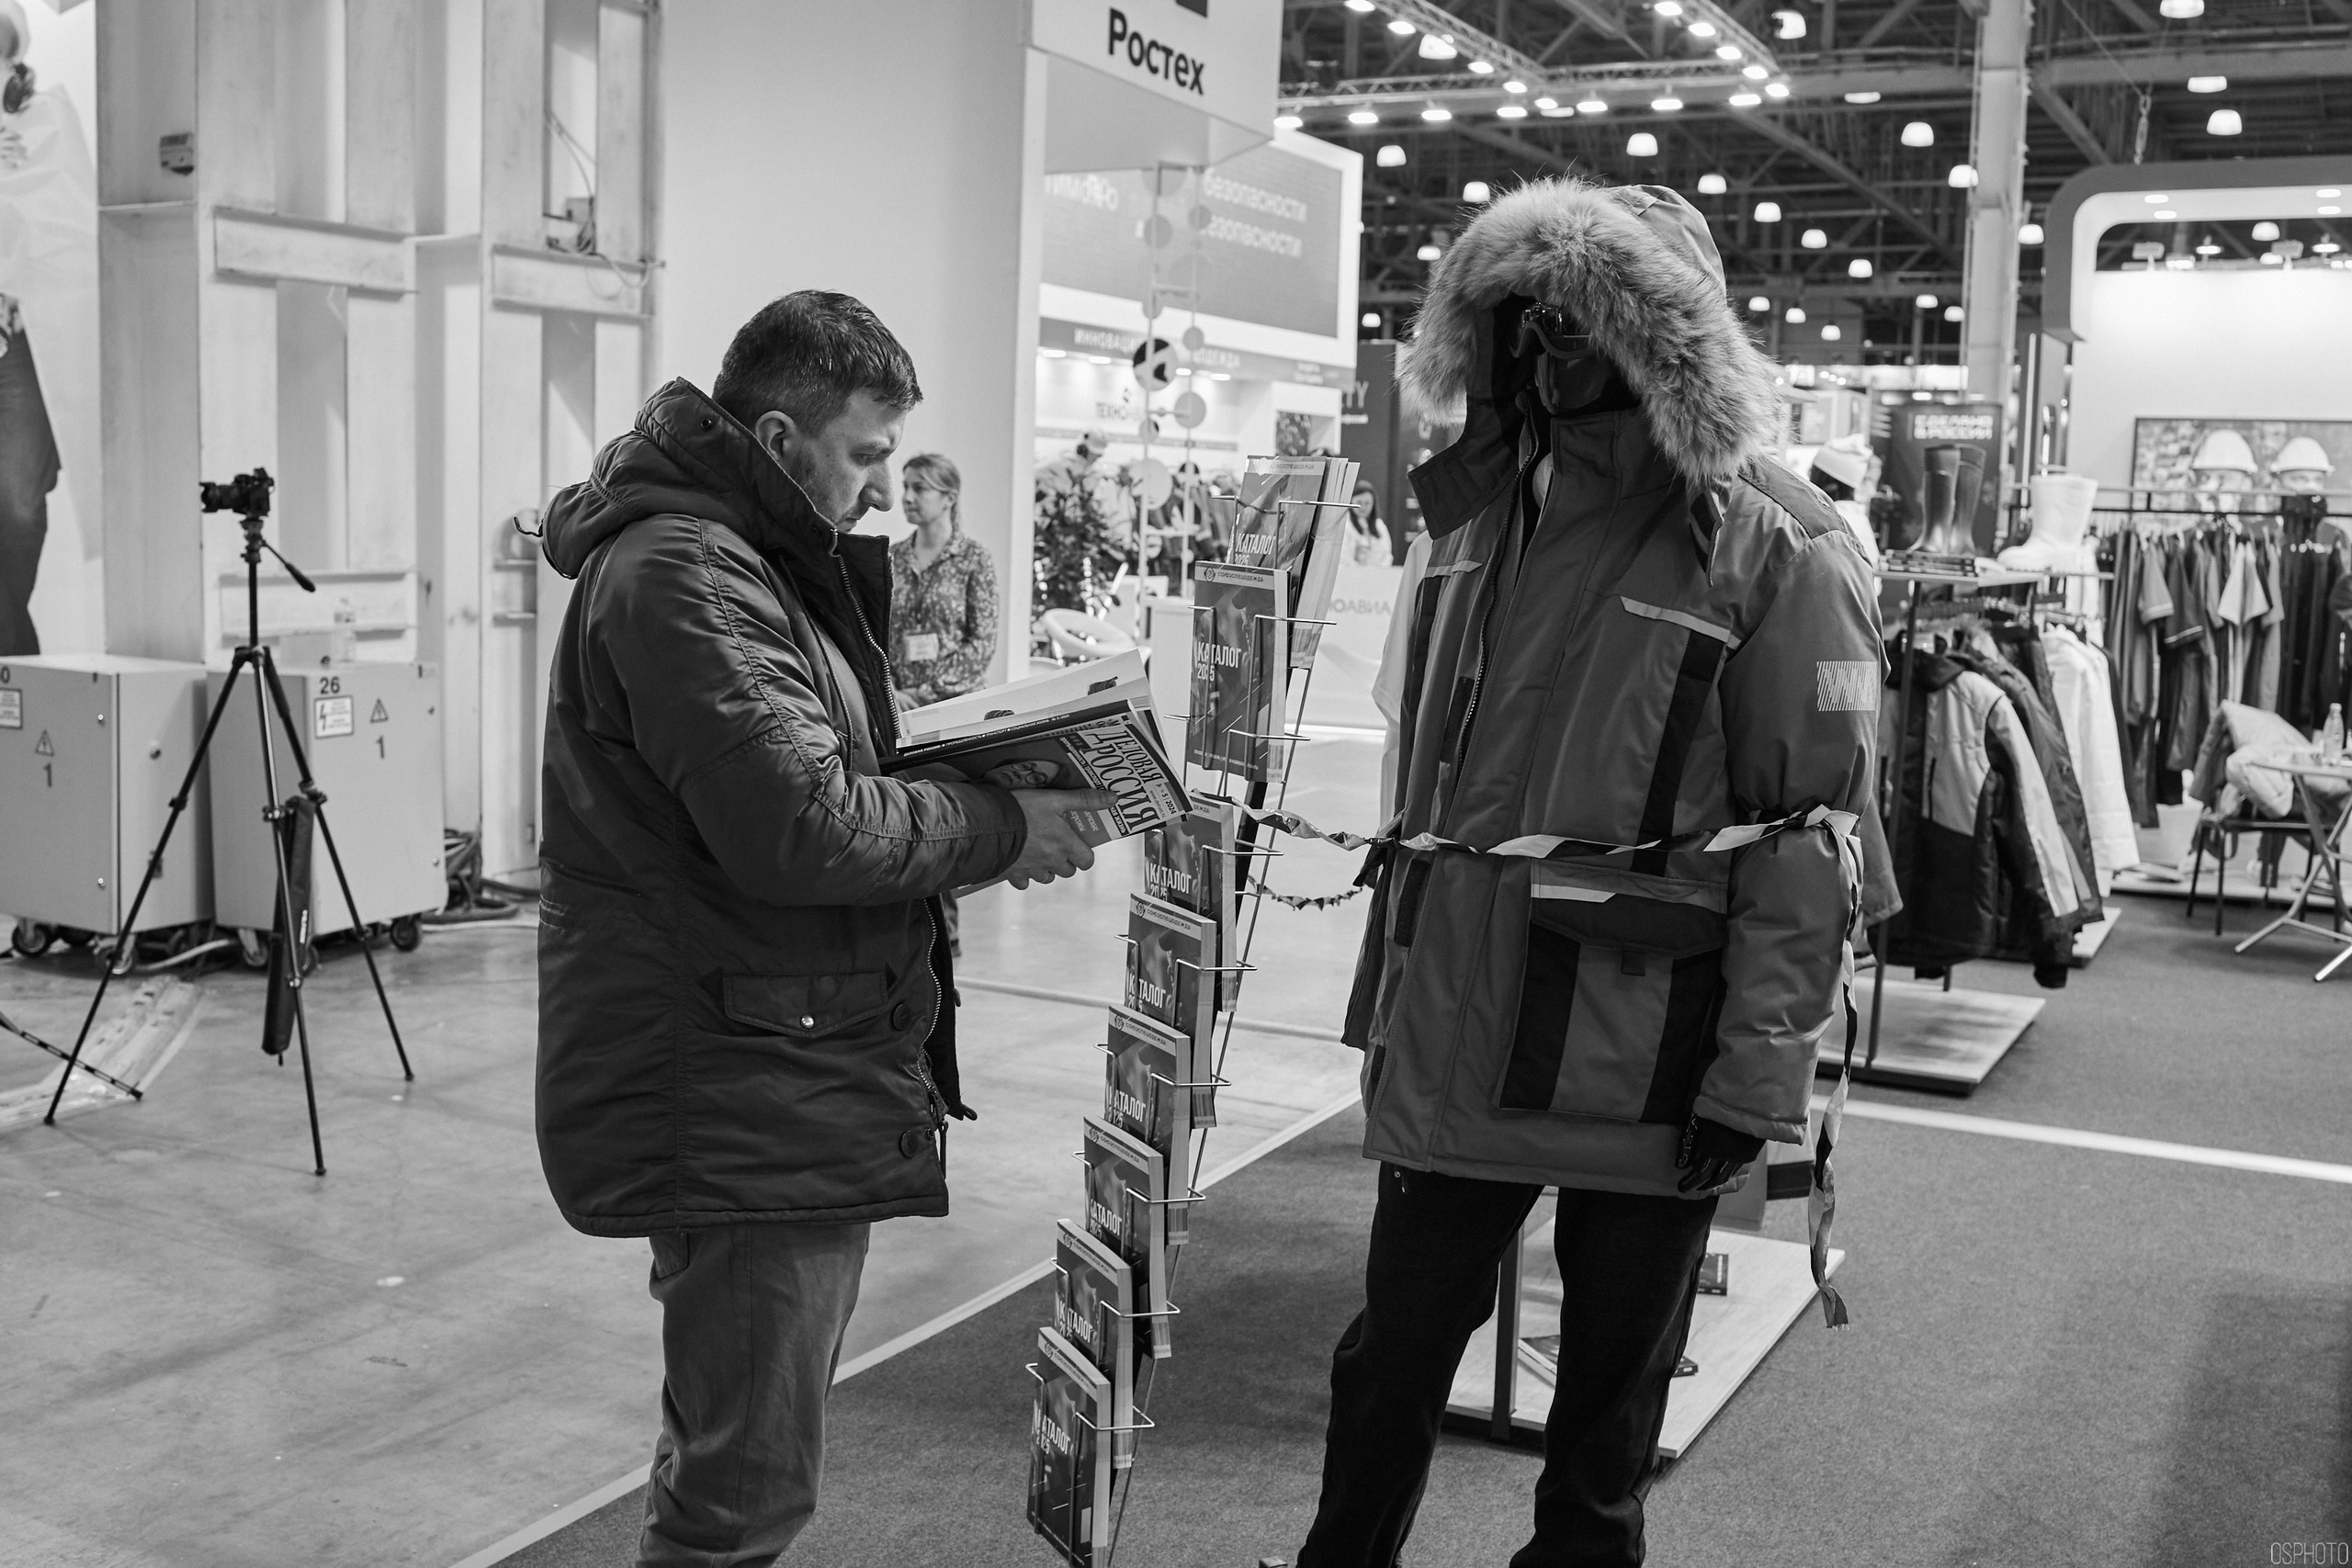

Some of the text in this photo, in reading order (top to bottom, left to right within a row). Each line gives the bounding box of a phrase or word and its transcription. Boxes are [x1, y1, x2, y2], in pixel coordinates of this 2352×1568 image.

[1108, 6, 1204, 96] Ростех
[1201, 214, 1302, 259] езопасности
[1235, 533, 1277, 555] КАТАЛОГ
[1217, 571, 1263, 582] СОЮЗСПЕЦОДЕЖДА
[320, 676, 341, 694] 26
[375, 735, 385, 759] 1
[1084, 730, 1164, 784] ДЕЛОВАЯ
[43, 762, 52, 787] 1
[1079, 743, 1160, 831] РОССИЯ
[1165, 799, 1177, 815] 2024
[1129, 973, 1166, 1009] КТАЛОГ
